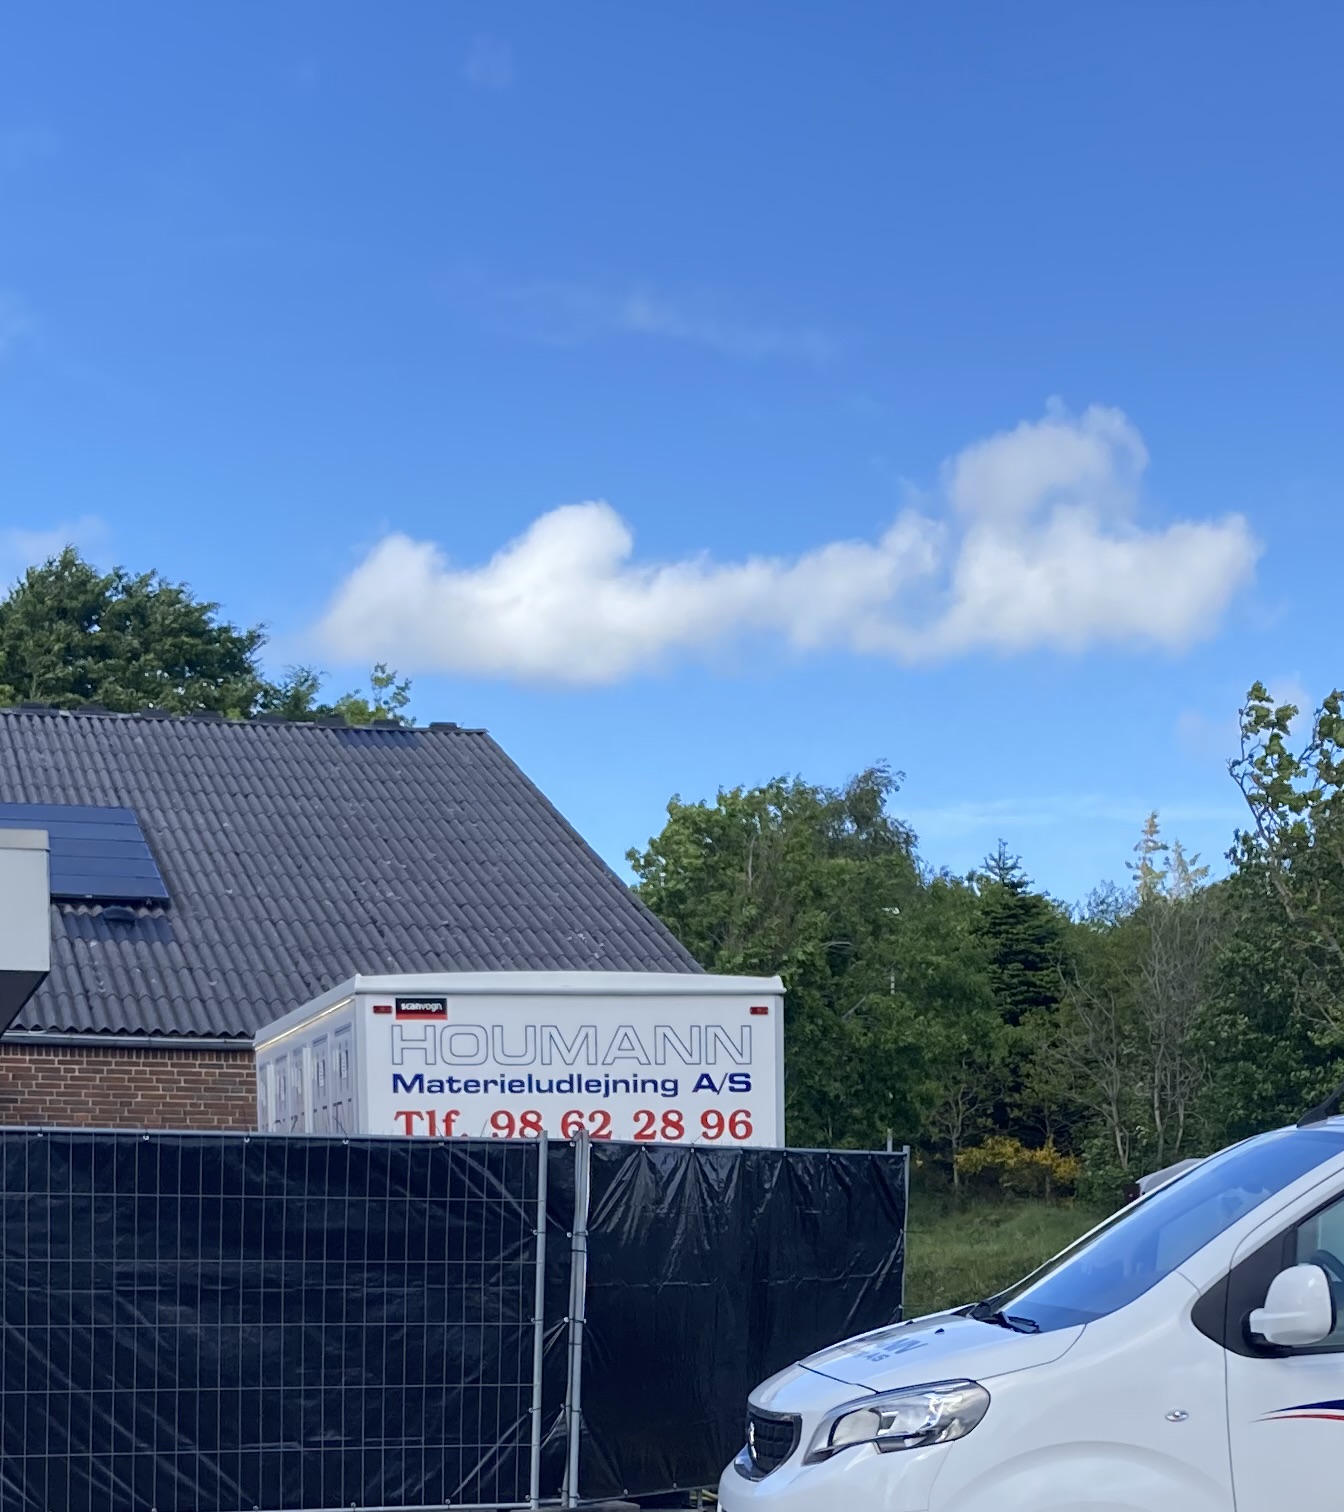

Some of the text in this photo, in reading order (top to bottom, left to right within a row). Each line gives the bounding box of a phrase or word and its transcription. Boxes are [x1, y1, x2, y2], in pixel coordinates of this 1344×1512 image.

[391, 1024, 753, 1066] HOUMANN
[392, 1072, 753, 1098] Materieludlejning A/S
[490, 1109, 544, 1139] 98
[560, 1109, 613, 1140] 62
[633, 1109, 685, 1141] 28
[700, 1108, 753, 1141] 96
